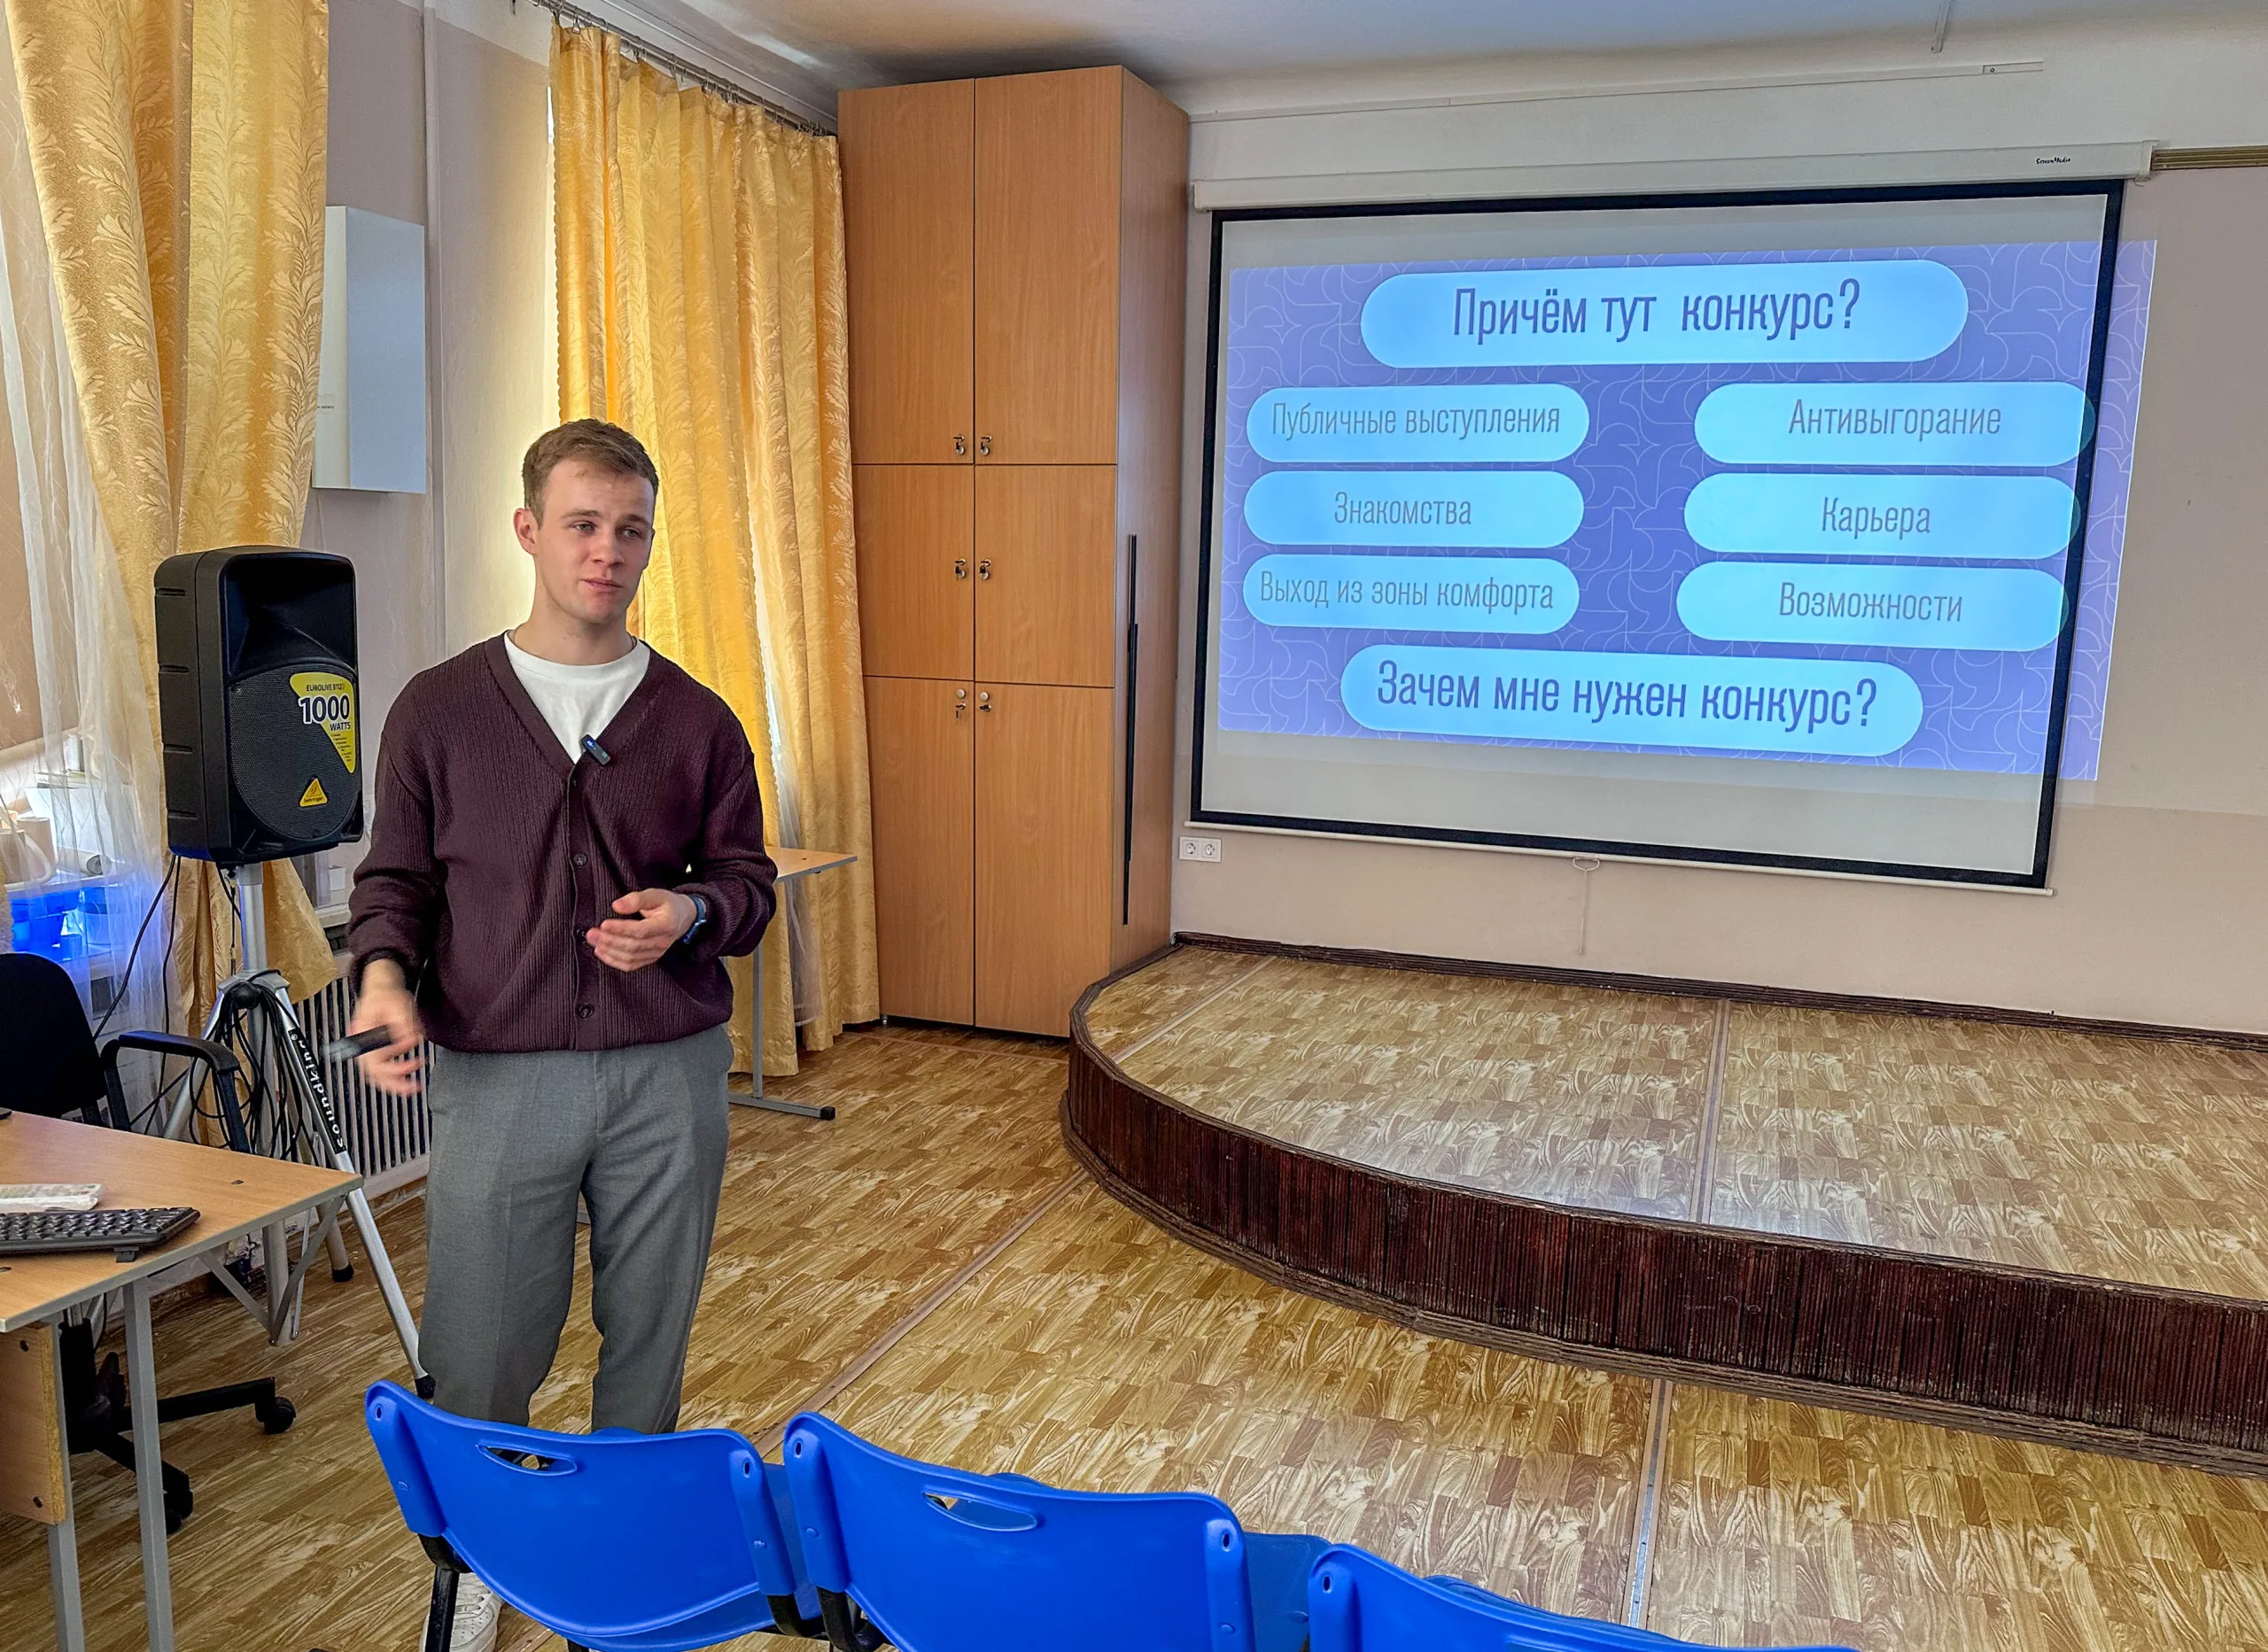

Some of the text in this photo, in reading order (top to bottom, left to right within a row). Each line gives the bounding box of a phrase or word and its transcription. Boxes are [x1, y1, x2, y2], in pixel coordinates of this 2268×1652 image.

[1453, 277, 1860, 345] Причём тут конкурс?
[1272, 402, 1560, 441] Публичные выступления
[1789, 399, 2001, 442] Антивыгорание
[1333, 491, 1472, 525] Знакомства
[1821, 496, 1930, 540] Карьера
[1261, 570, 1554, 615] Выход из зоны комфорта
[1779, 582, 1963, 622] Возможности
[299, 694, 350, 723] 1000
[1377, 659, 1877, 734] Зачем мне нужен конкурс?
[330, 722, 351, 732] WATTS
